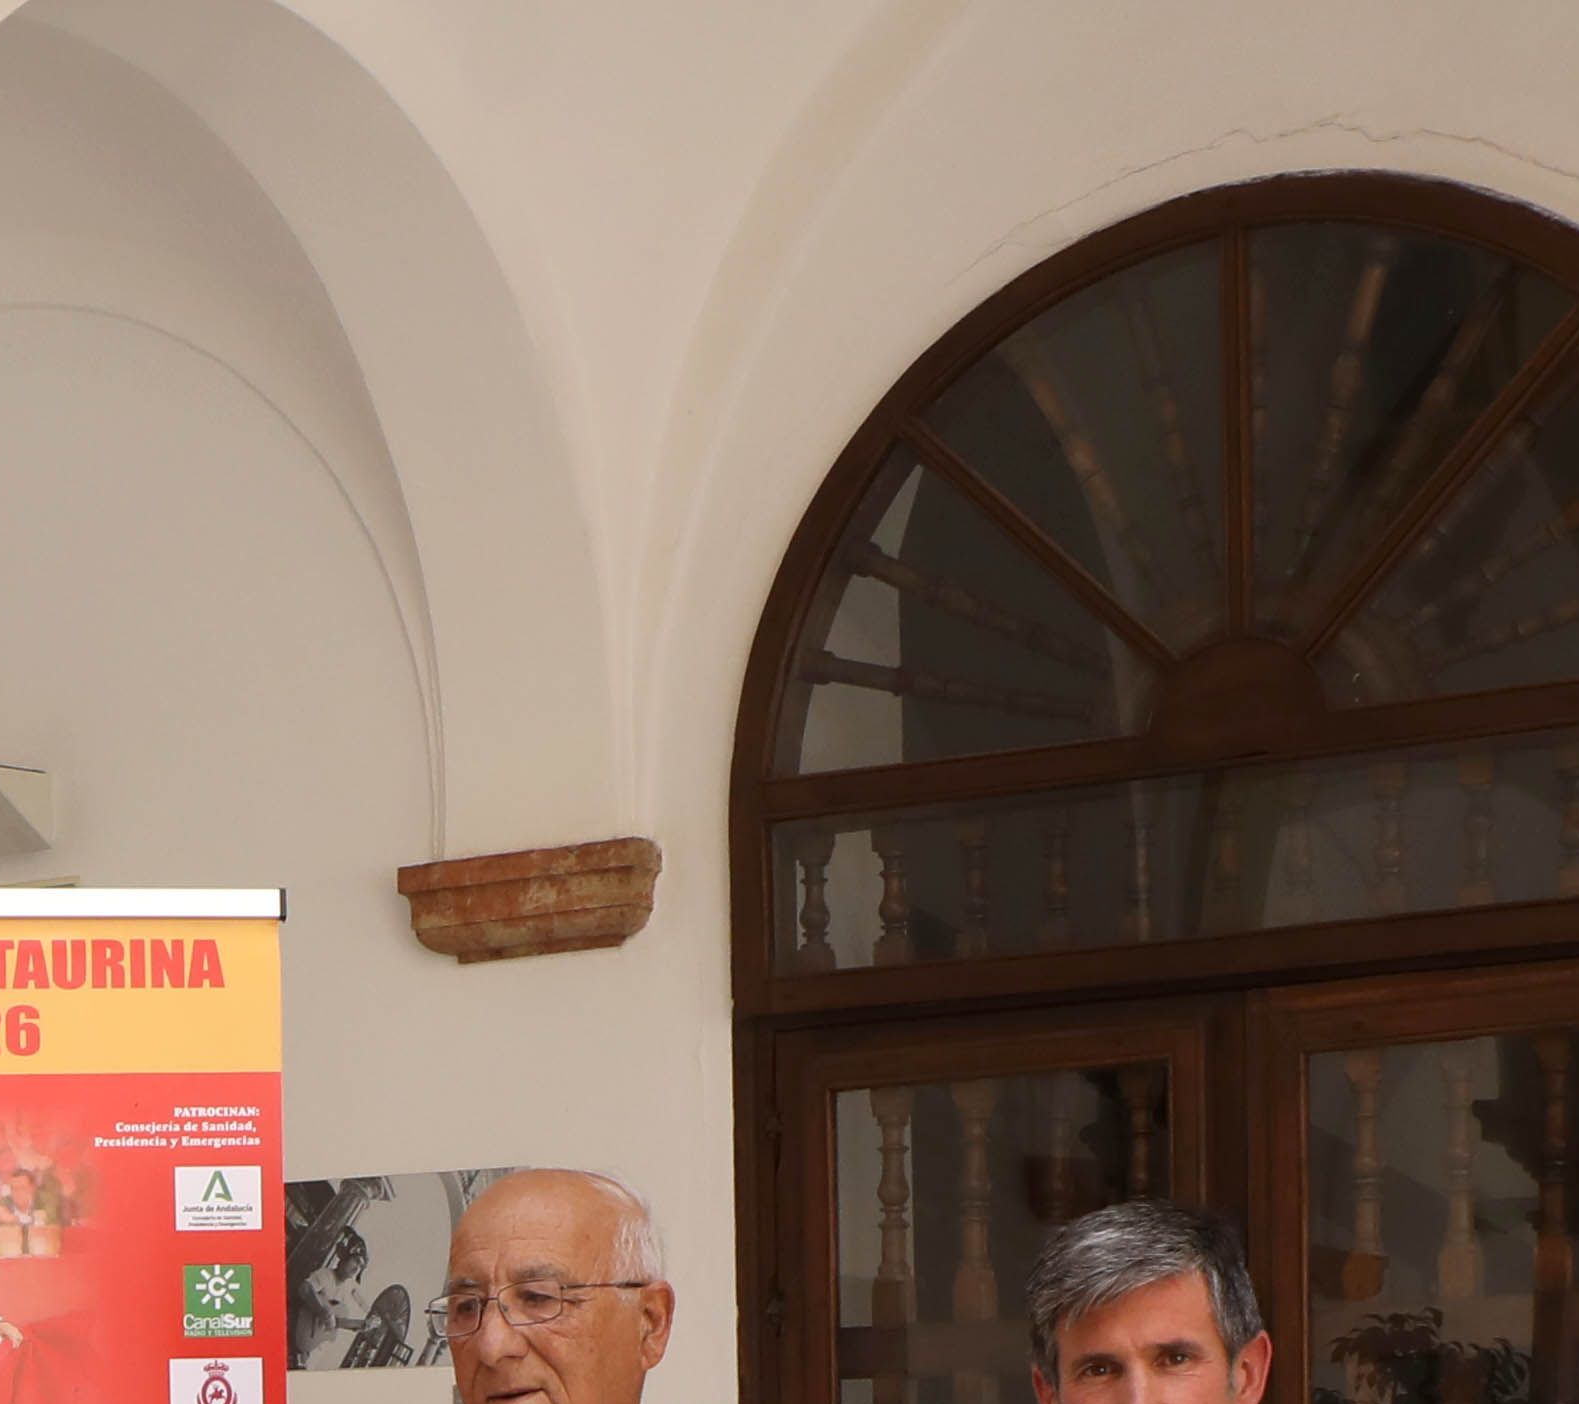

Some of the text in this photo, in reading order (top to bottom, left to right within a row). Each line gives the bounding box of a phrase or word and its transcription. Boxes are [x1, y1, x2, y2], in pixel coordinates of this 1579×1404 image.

[174, 1107, 260, 1117] PATROCINAN:
[115, 1121, 256, 1134] Consejería de Sanidad,
[94, 1135, 260, 1148] Presidencia y Emergencias
